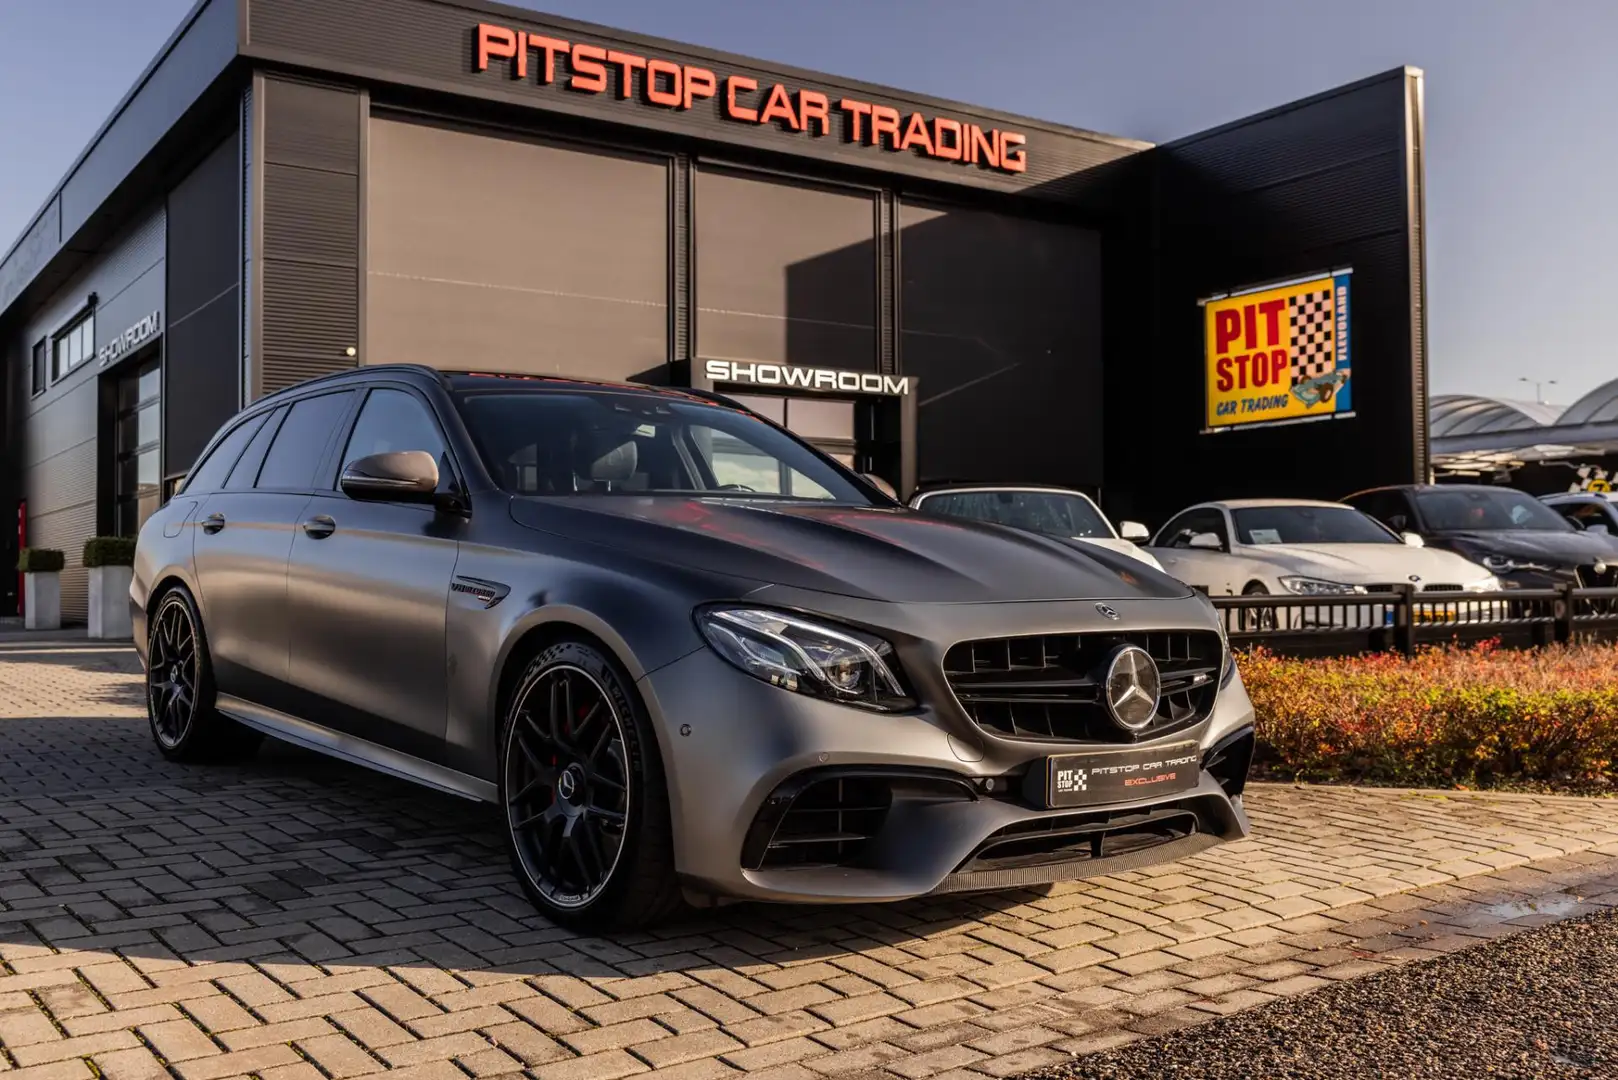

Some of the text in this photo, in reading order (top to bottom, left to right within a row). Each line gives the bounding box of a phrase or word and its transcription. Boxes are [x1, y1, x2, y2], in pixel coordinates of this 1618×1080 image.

[477, 23, 1027, 173] PITSTOP CAR TRADING
[99, 309, 159, 367] SHOWROOM
[1215, 299, 1286, 355] PIT
[705, 360, 909, 395] SHOWROOM
[1216, 349, 1288, 392] STOP
[1216, 394, 1289, 416] CAR TRADING
[1057, 770, 1074, 781] PIT
[1091, 754, 1197, 776] PITSTOP CAR TRADING
[1057, 780, 1073, 789] STOP
[1124, 772, 1176, 787] EXCLUSIVE
